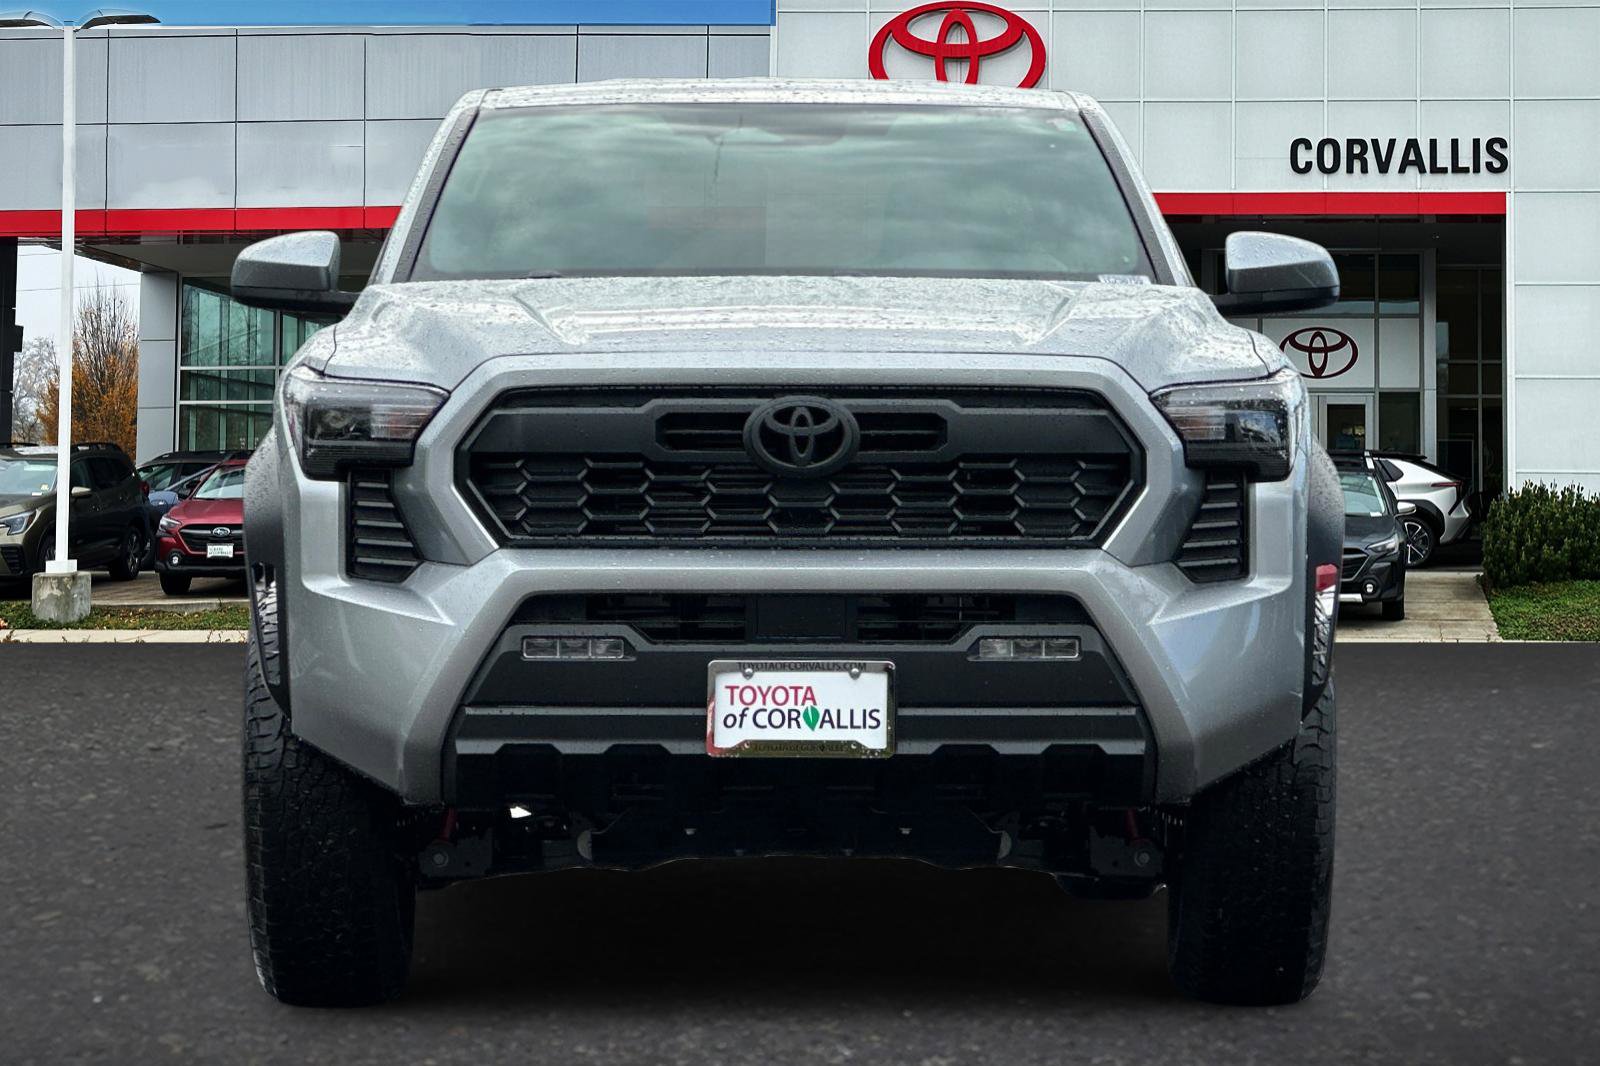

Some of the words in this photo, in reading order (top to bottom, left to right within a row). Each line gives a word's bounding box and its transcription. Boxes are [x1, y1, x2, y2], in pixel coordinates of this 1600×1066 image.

[1290, 137, 1509, 174] CORVALLIS
[725, 685, 817, 706] TOYOTA
[723, 707, 750, 729] of
